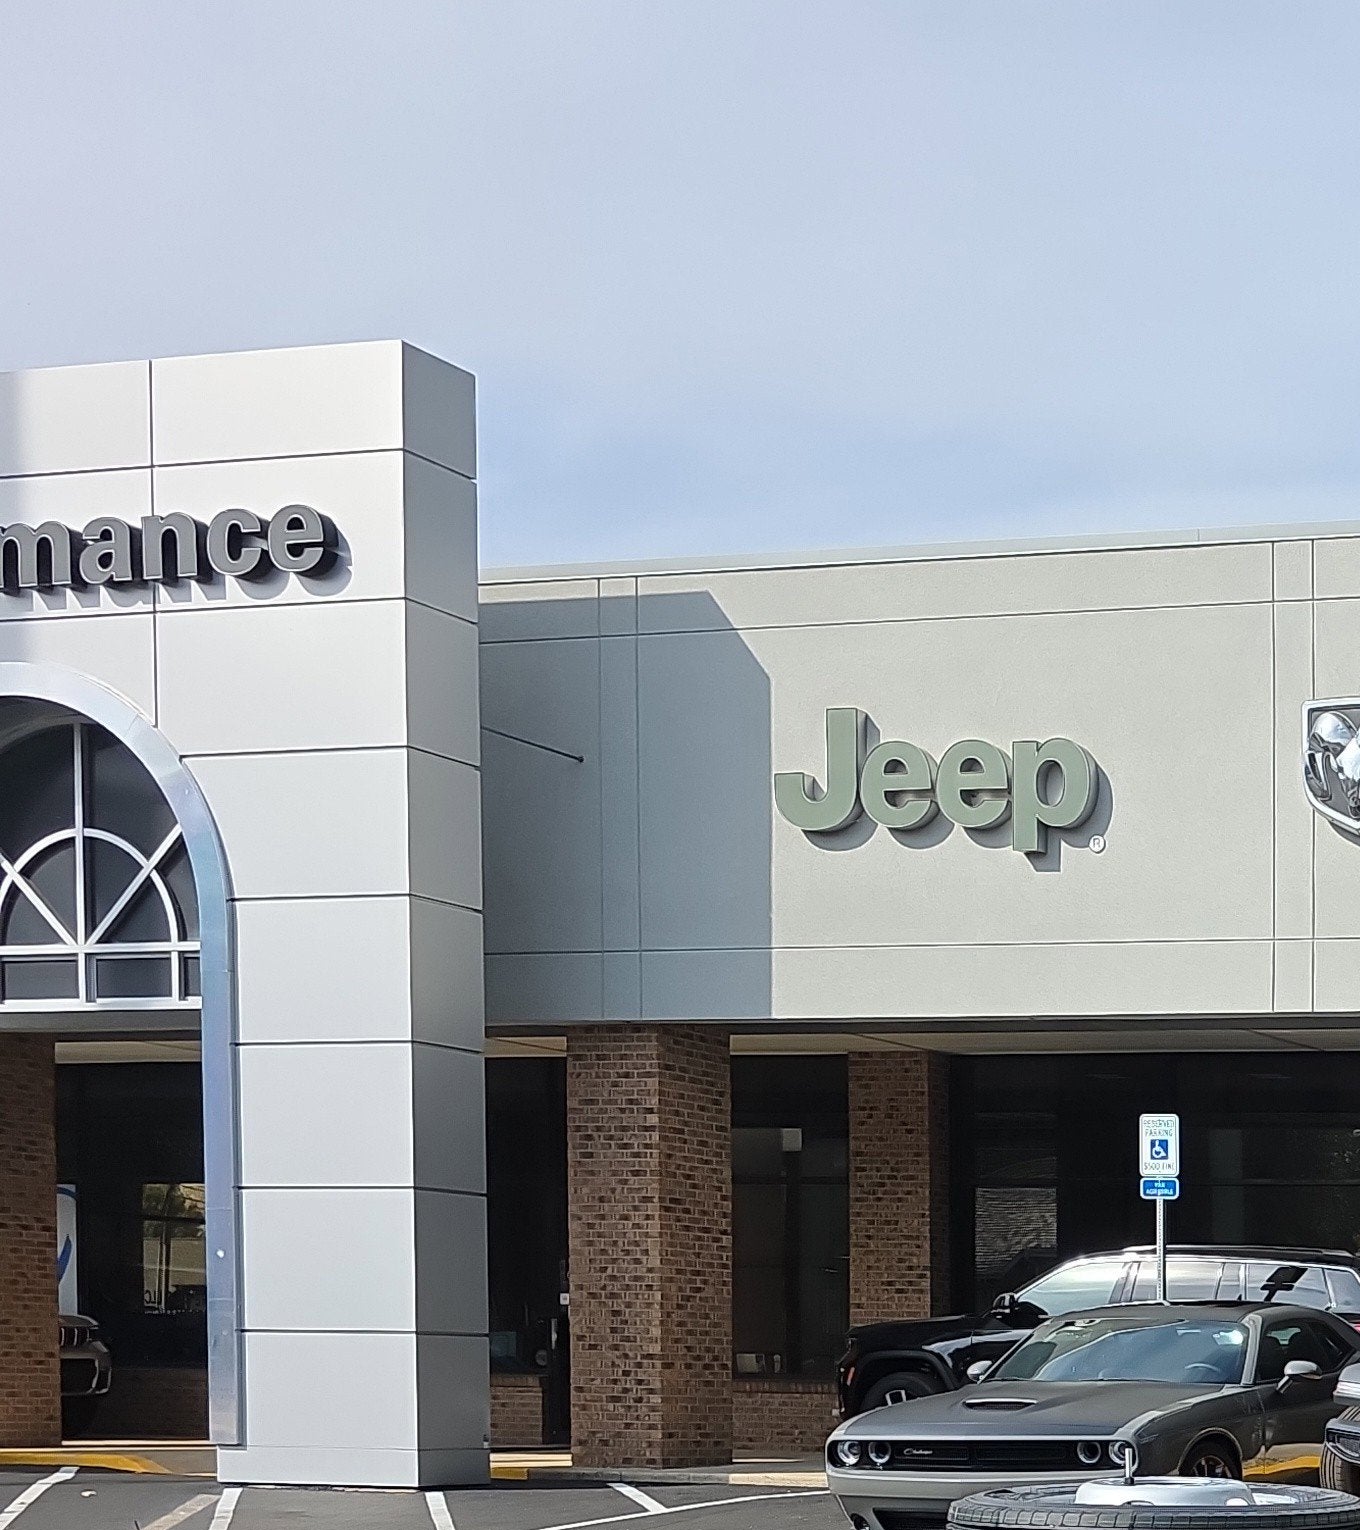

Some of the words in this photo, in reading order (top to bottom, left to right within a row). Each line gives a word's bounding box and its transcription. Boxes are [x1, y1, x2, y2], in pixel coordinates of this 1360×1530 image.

[0, 504, 332, 588] mance
[774, 707, 1098, 853] Jeep
[1145, 1128, 1173, 1137] PARKING
